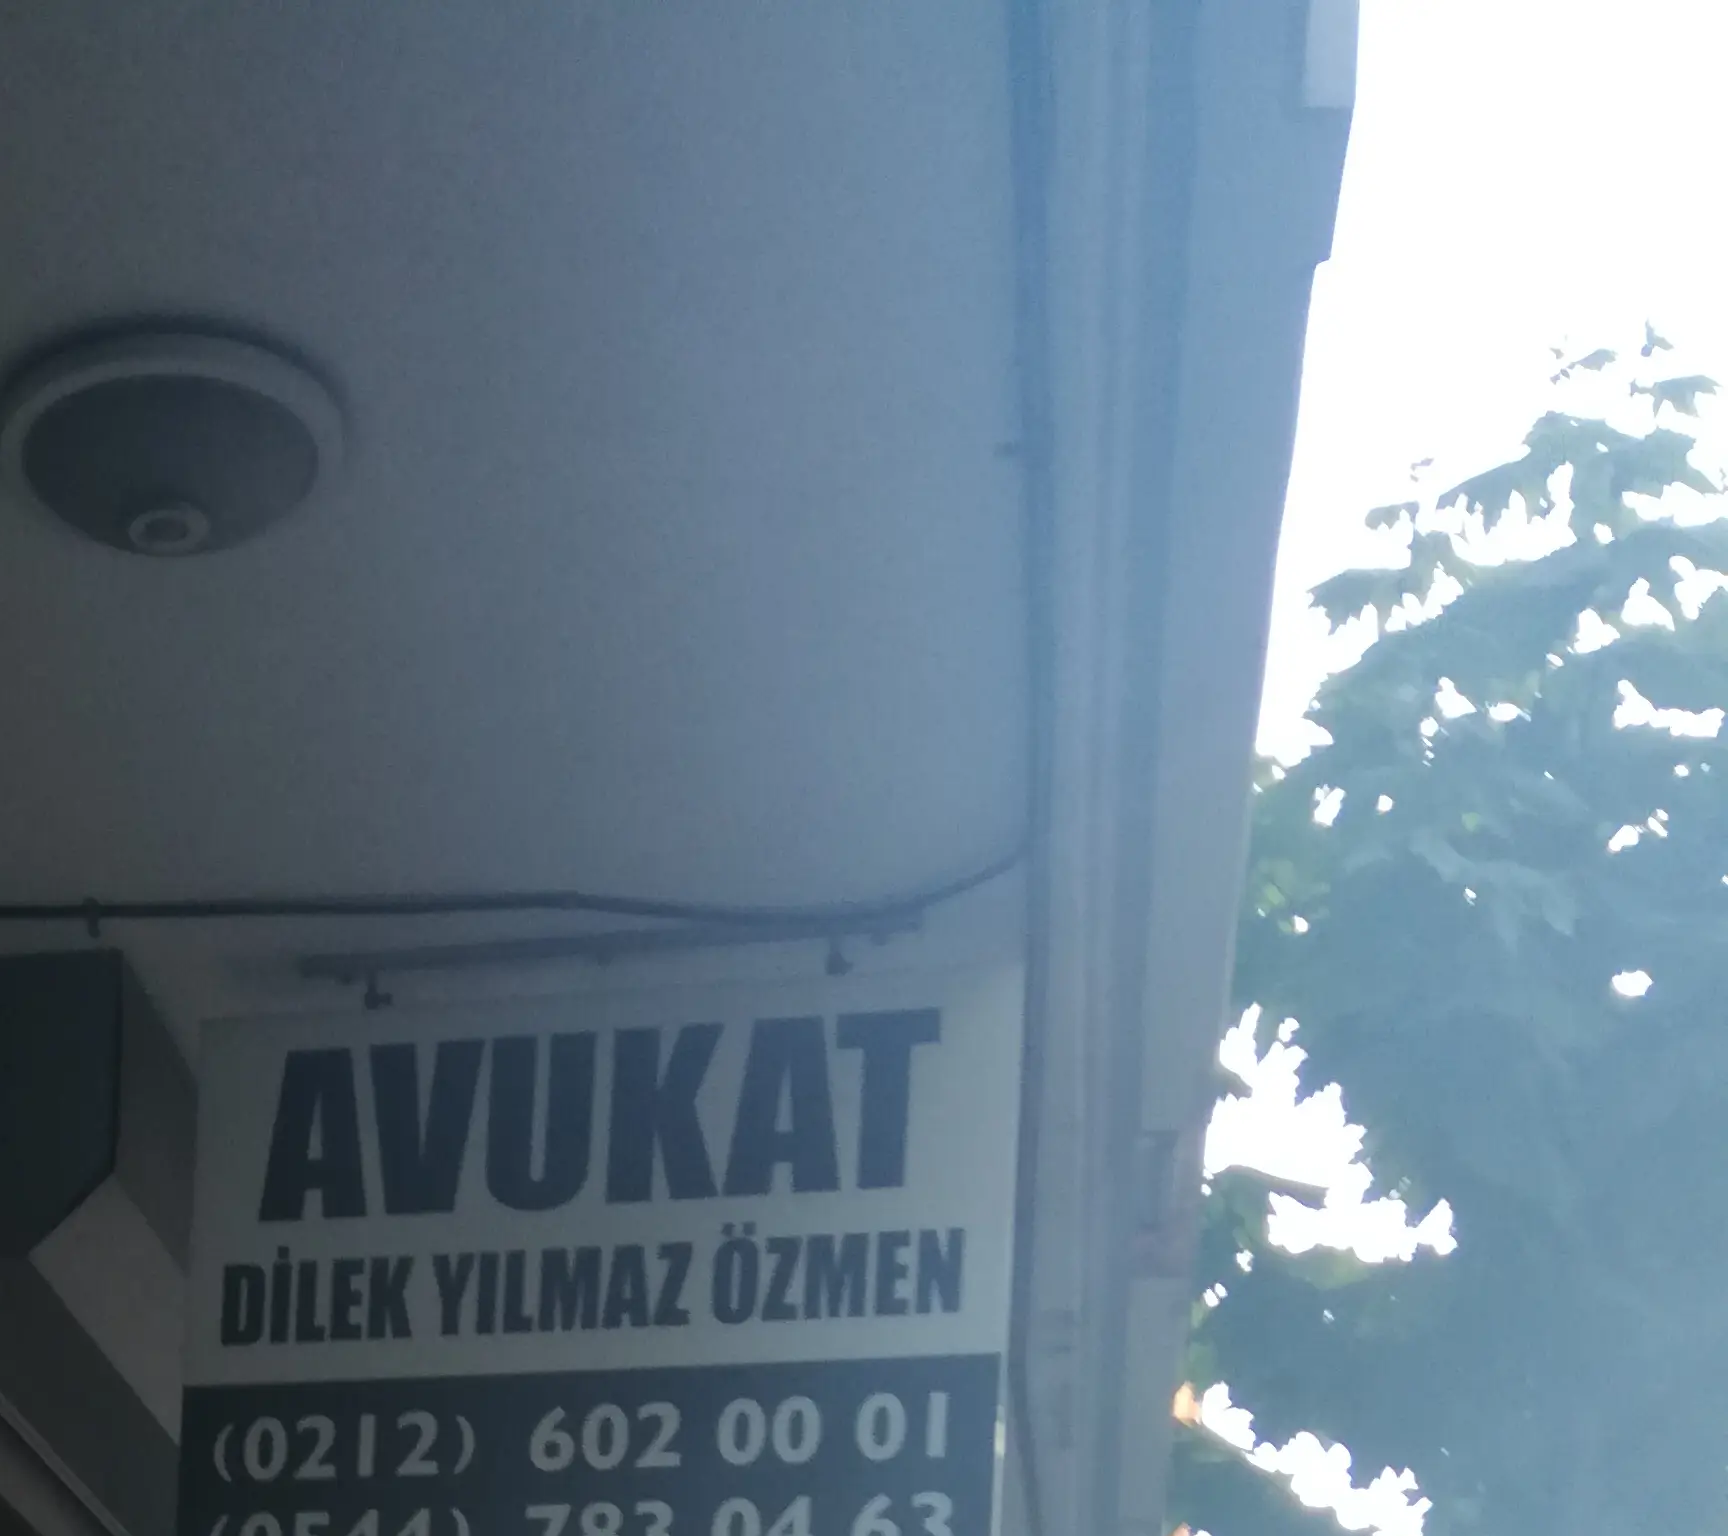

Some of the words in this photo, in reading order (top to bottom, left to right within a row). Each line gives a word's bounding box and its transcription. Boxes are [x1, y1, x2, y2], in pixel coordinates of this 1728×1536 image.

[258, 1008, 941, 1223] AVUKAT
[220, 1244, 414, 1347] DİLEK
[433, 1241, 695, 1336] YILMAZ
[711, 1221, 967, 1324] ÖZMEN
[213, 1411, 475, 1483] (0212)
[528, 1402, 683, 1472] 602
[716, 1396, 822, 1466] 00
[854, 1391, 949, 1462] 01
